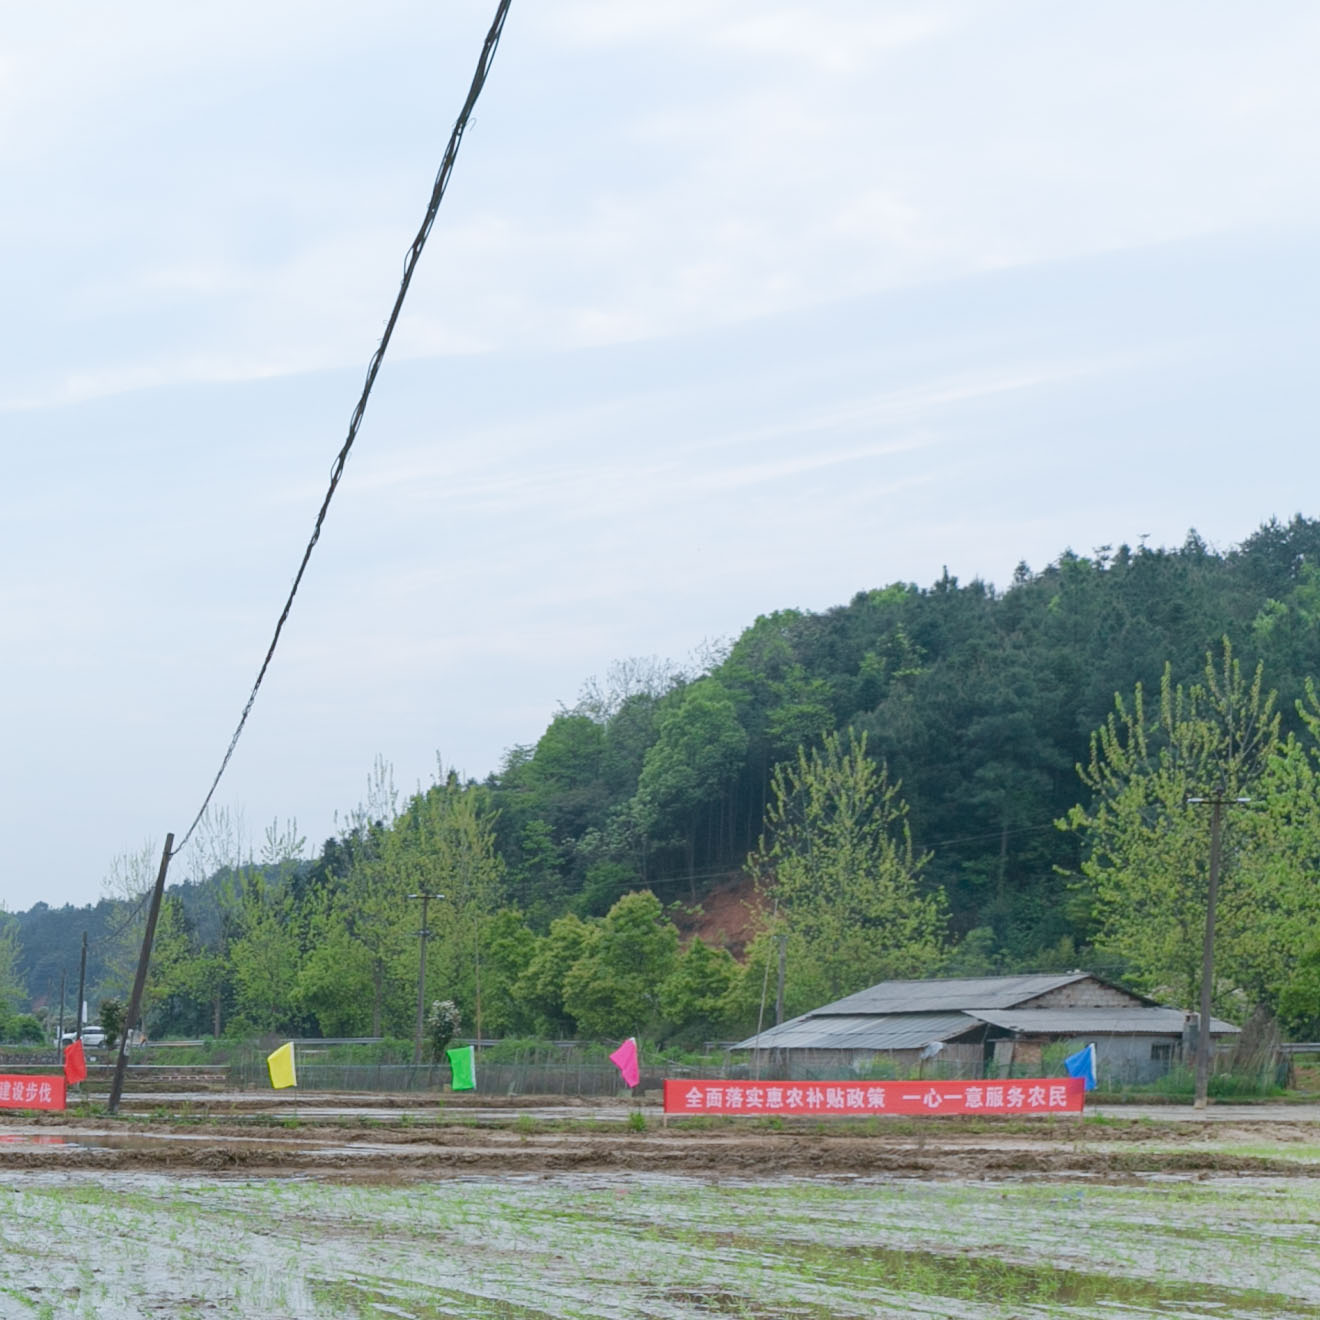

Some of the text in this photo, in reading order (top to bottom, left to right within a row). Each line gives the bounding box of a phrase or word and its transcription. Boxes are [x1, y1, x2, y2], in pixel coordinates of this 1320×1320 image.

[685, 1085, 1068, 1109] 全面落实惠农补贴政策 一心一意服务农民
